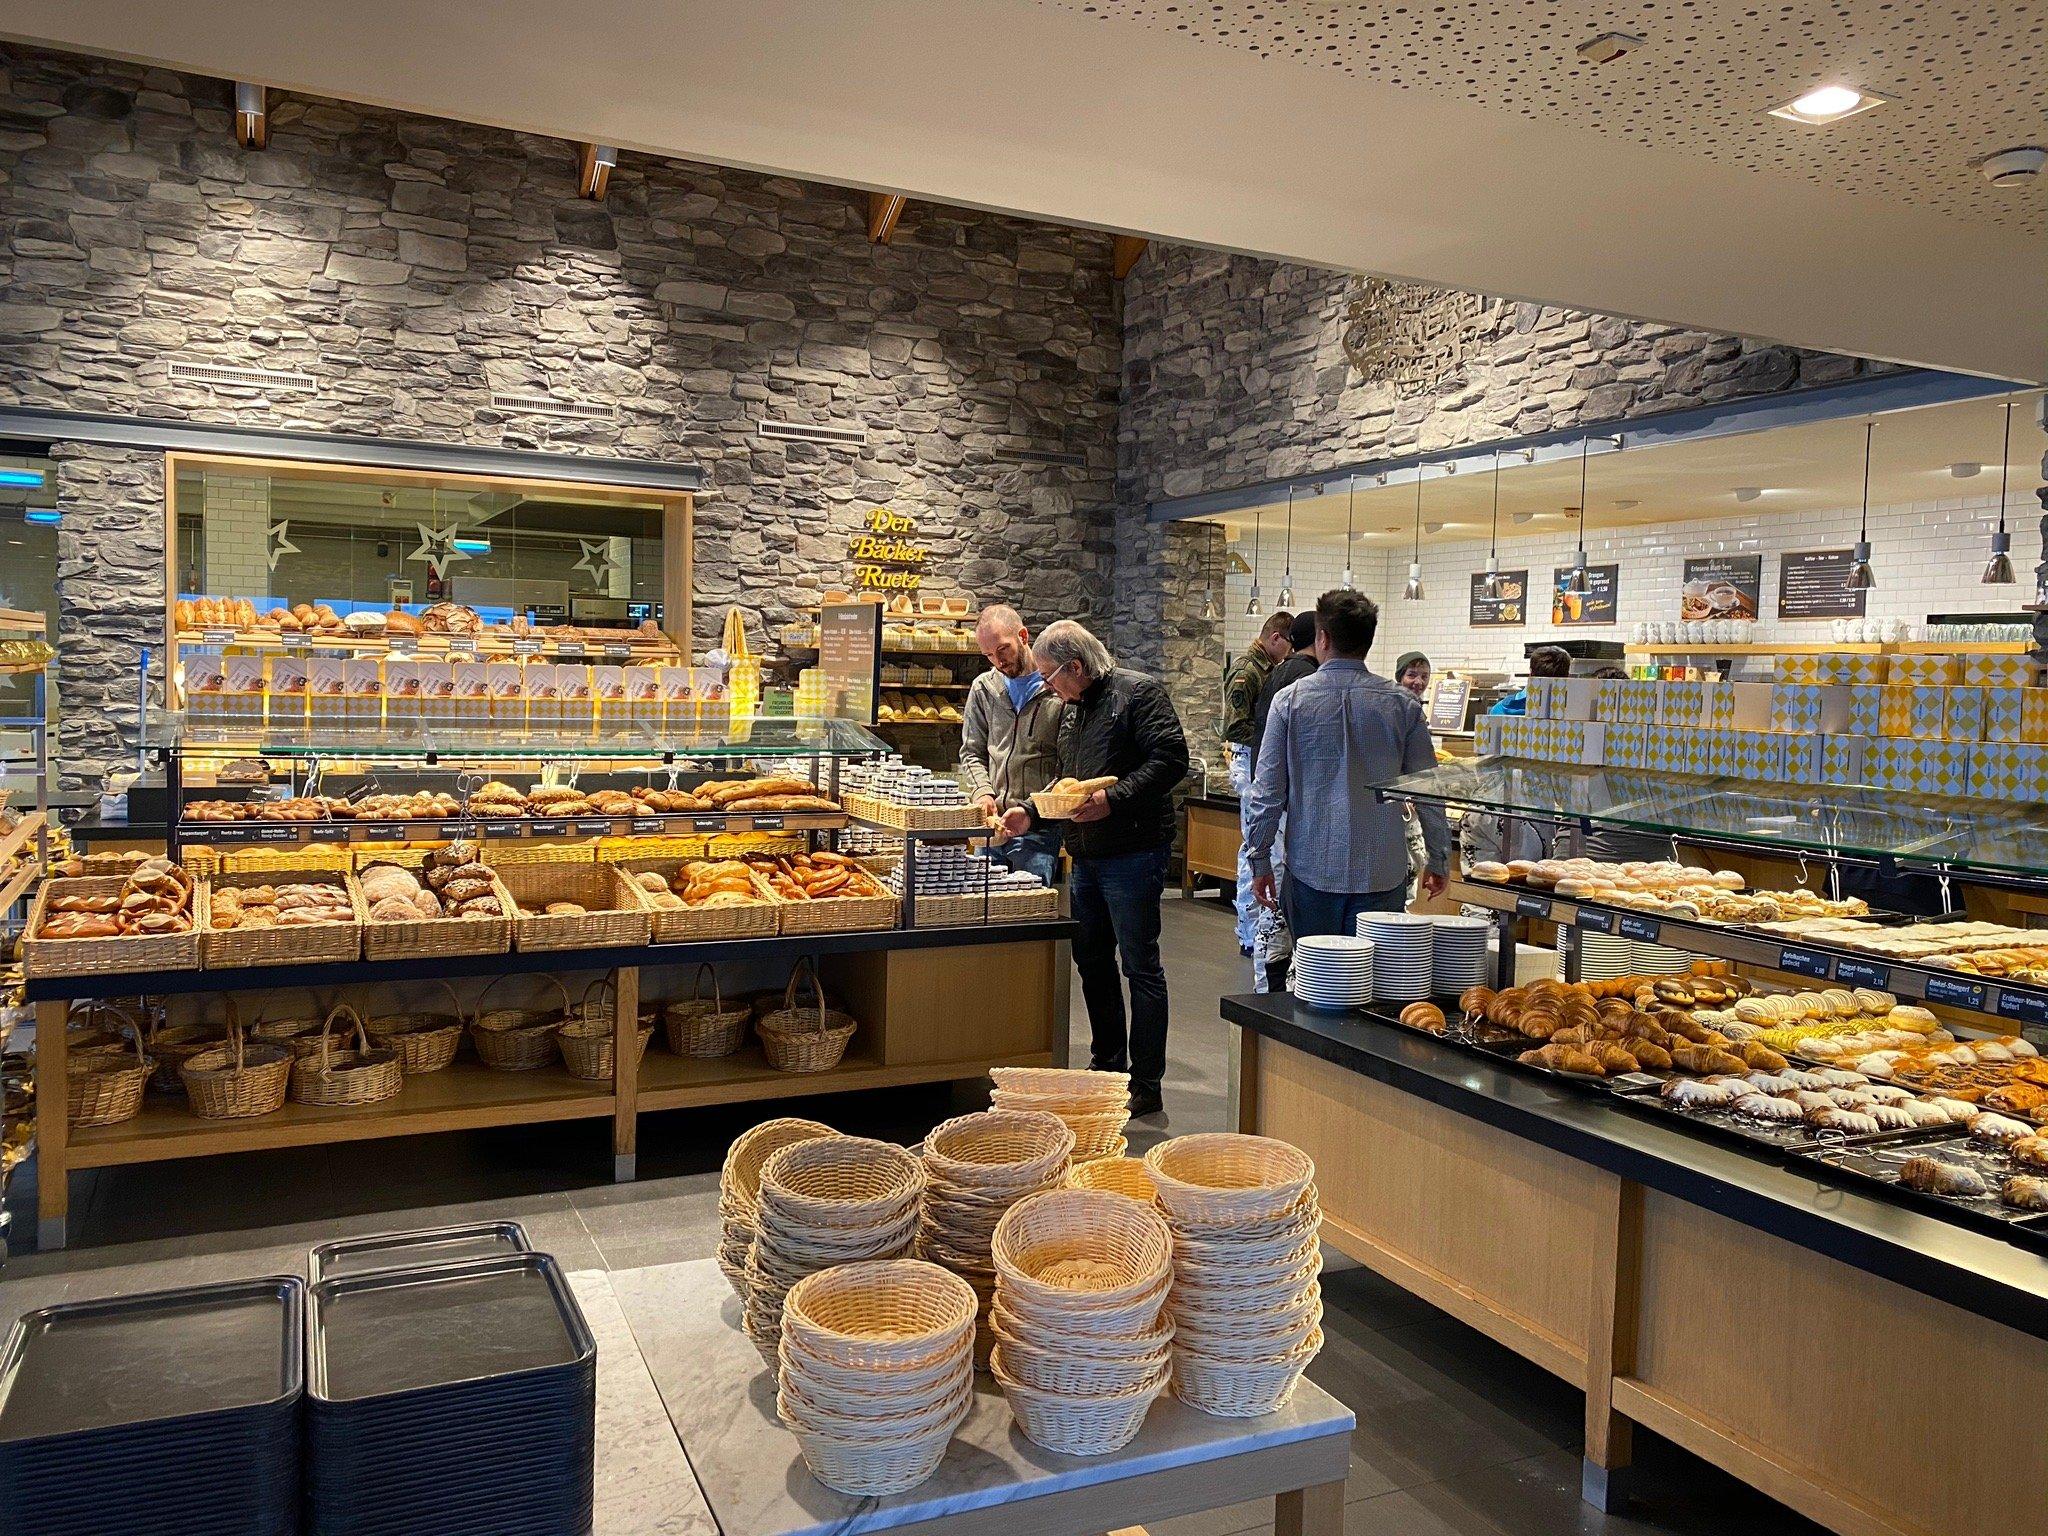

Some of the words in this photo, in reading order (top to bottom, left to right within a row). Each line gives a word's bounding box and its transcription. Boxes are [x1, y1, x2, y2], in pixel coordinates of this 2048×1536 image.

[866, 508, 917, 532] Der
[850, 536, 927, 562] Bäcker
[856, 564, 922, 589] Ruetz
[1782, 951, 1810, 963] Apfelkuchen
[1839, 969, 1854, 978] Kipferl
[1840, 963, 1874, 974] Nougat-Vanille-
[2001, 1001, 2020, 1011] Kipferl
